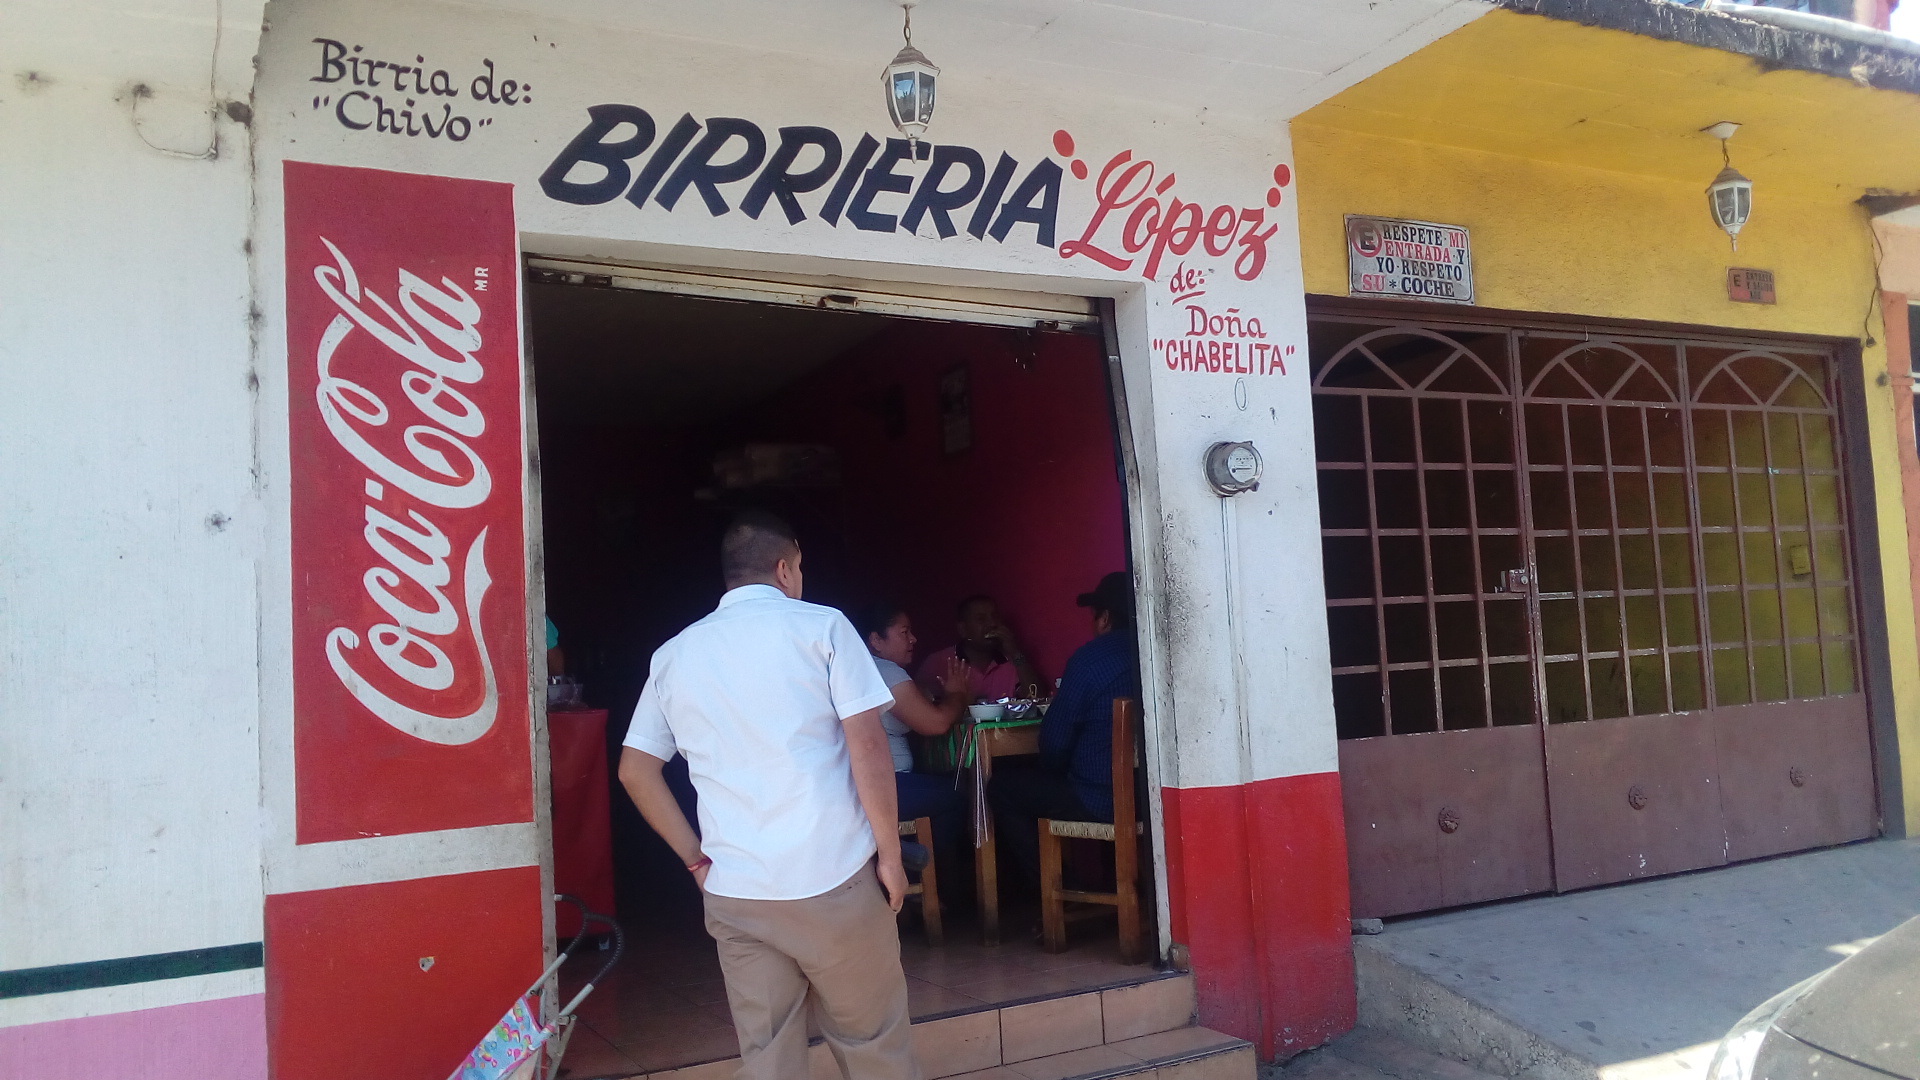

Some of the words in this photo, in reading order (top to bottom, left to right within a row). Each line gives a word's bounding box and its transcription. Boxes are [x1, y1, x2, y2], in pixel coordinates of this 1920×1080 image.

[309, 37, 459, 97] Birria
[470, 58, 532, 106] de:
[312, 90, 493, 142] "Chivo"
[538, 103, 1063, 249] BIRRIERIA
[1058, 149, 1278, 282] López
[1383, 224, 1443, 246] RESPETE
[1448, 231, 1465, 248] MI
[1384, 241, 1452, 263] ENTRADA
[1456, 249, 1465, 264] Y
[474, 266, 488, 291] MR
[1169, 261, 1206, 294] de:
[1376, 256, 1394, 274] YO
[1402, 259, 1462, 281] RESPETO
[1362, 274, 1386, 291] SU
[1401, 277, 1455, 297] COCHE
[1185, 305, 1267, 339] Doña
[1153, 338, 1295, 376] "CHABELITA"
[314, 236, 498, 746] Coca-Cola
